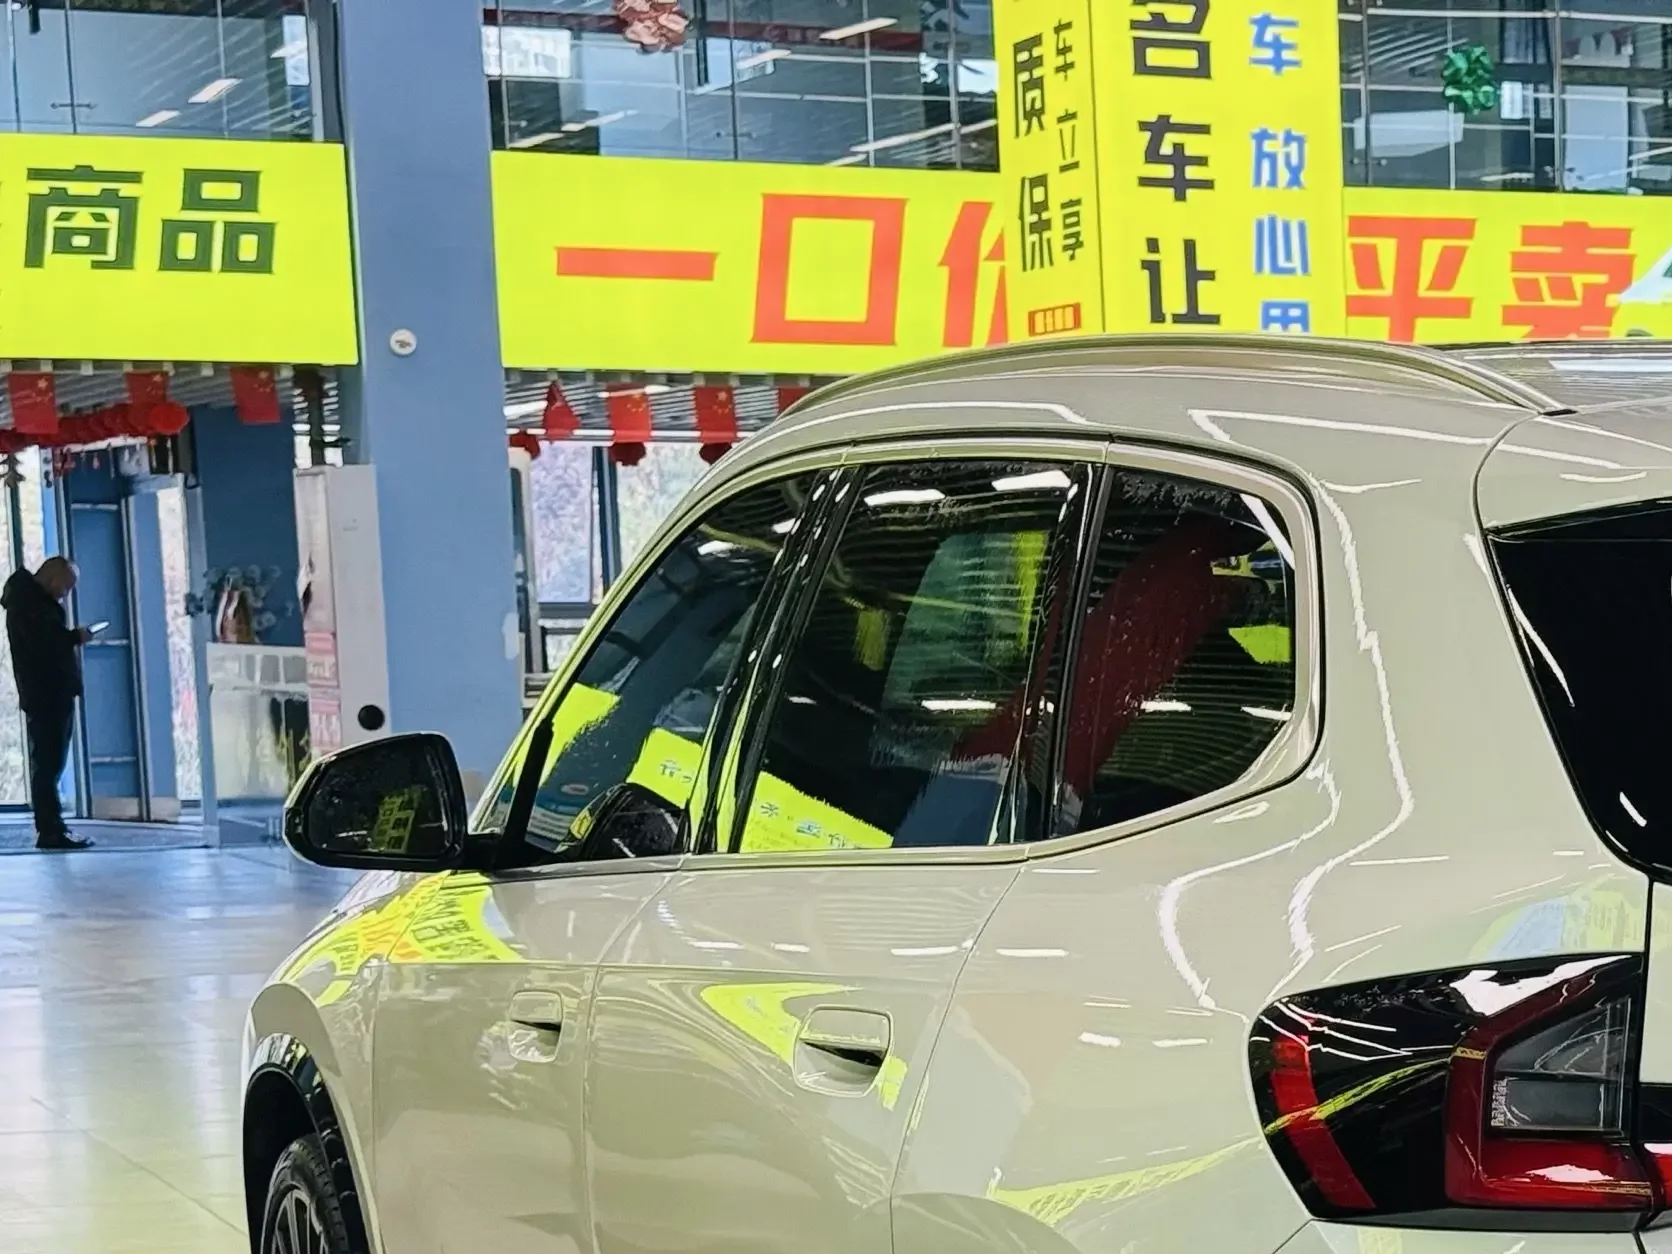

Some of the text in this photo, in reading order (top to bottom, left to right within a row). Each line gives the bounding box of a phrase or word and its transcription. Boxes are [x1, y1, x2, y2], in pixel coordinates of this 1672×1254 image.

[24, 164, 279, 274] 商品
[1012, 32, 1054, 273] 质保
[1053, 18, 1084, 262] 车立享
[1345, 215, 1637, 343] 平卖
